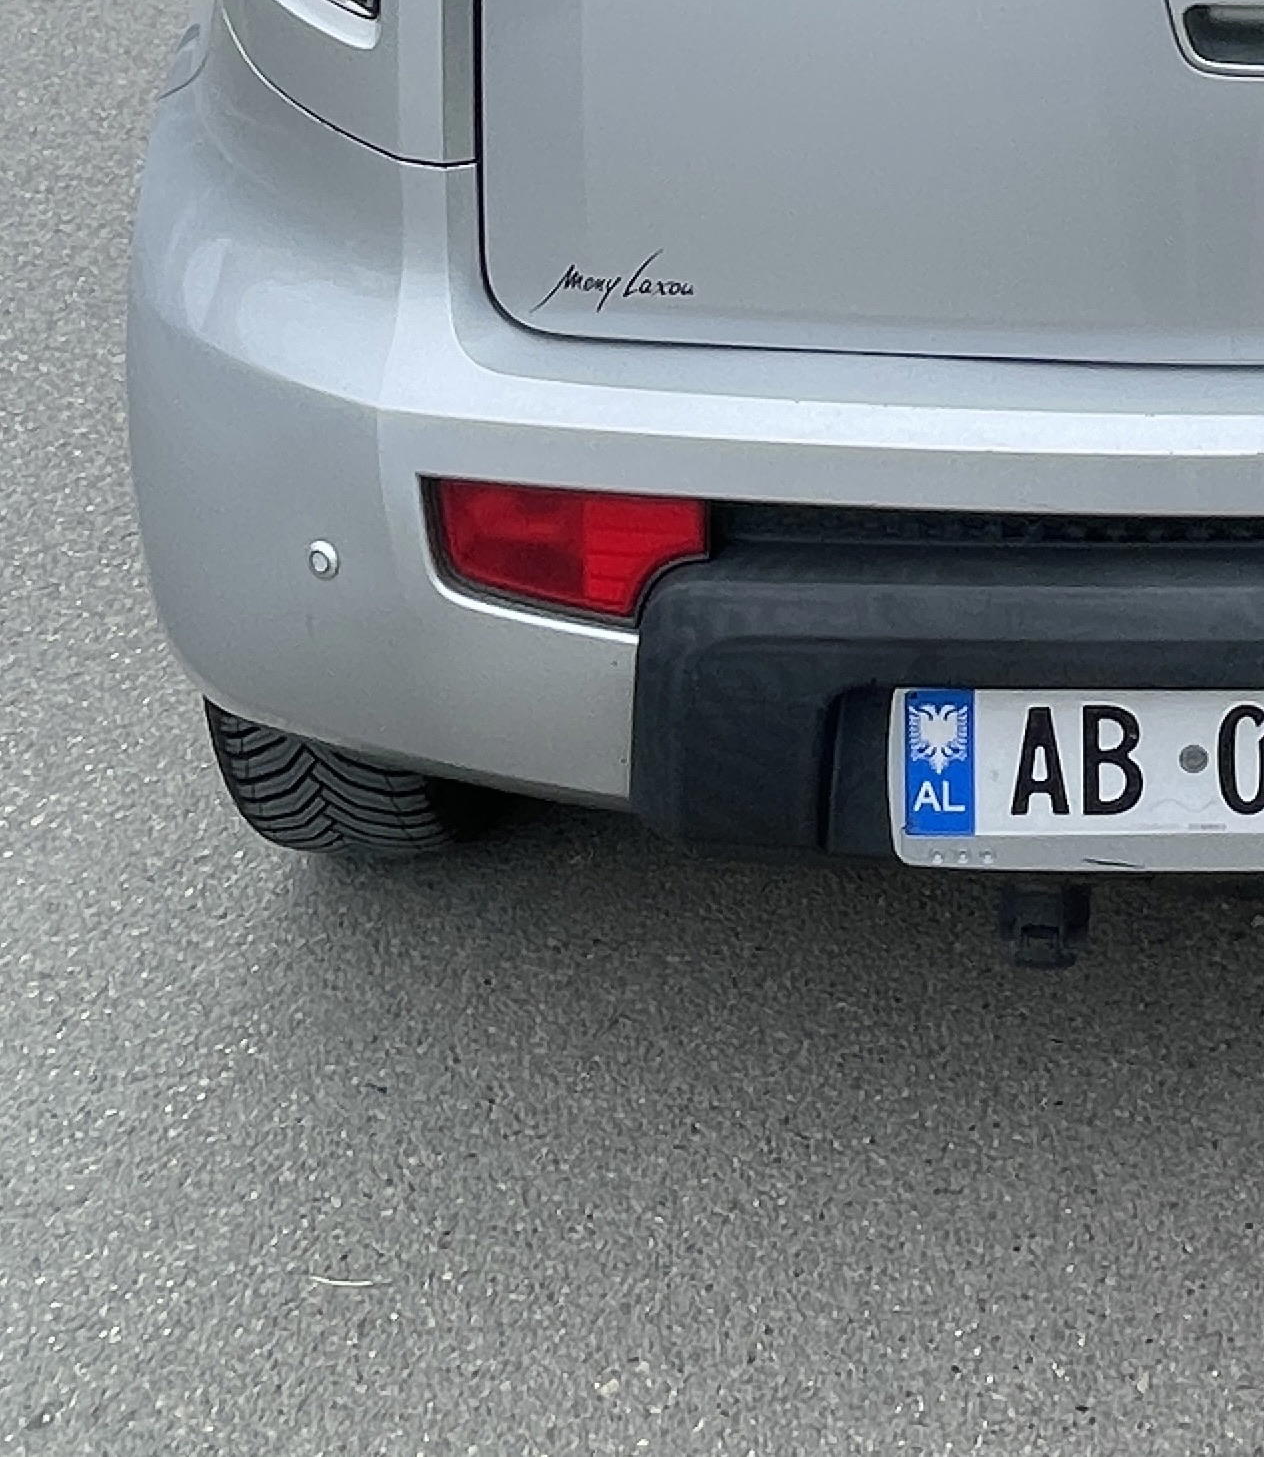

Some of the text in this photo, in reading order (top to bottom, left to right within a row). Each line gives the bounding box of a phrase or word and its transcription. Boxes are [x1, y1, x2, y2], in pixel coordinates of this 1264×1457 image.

[622, 247, 694, 298] Laxou
[1010, 704, 1145, 816] AB
[912, 779, 966, 813] AL
